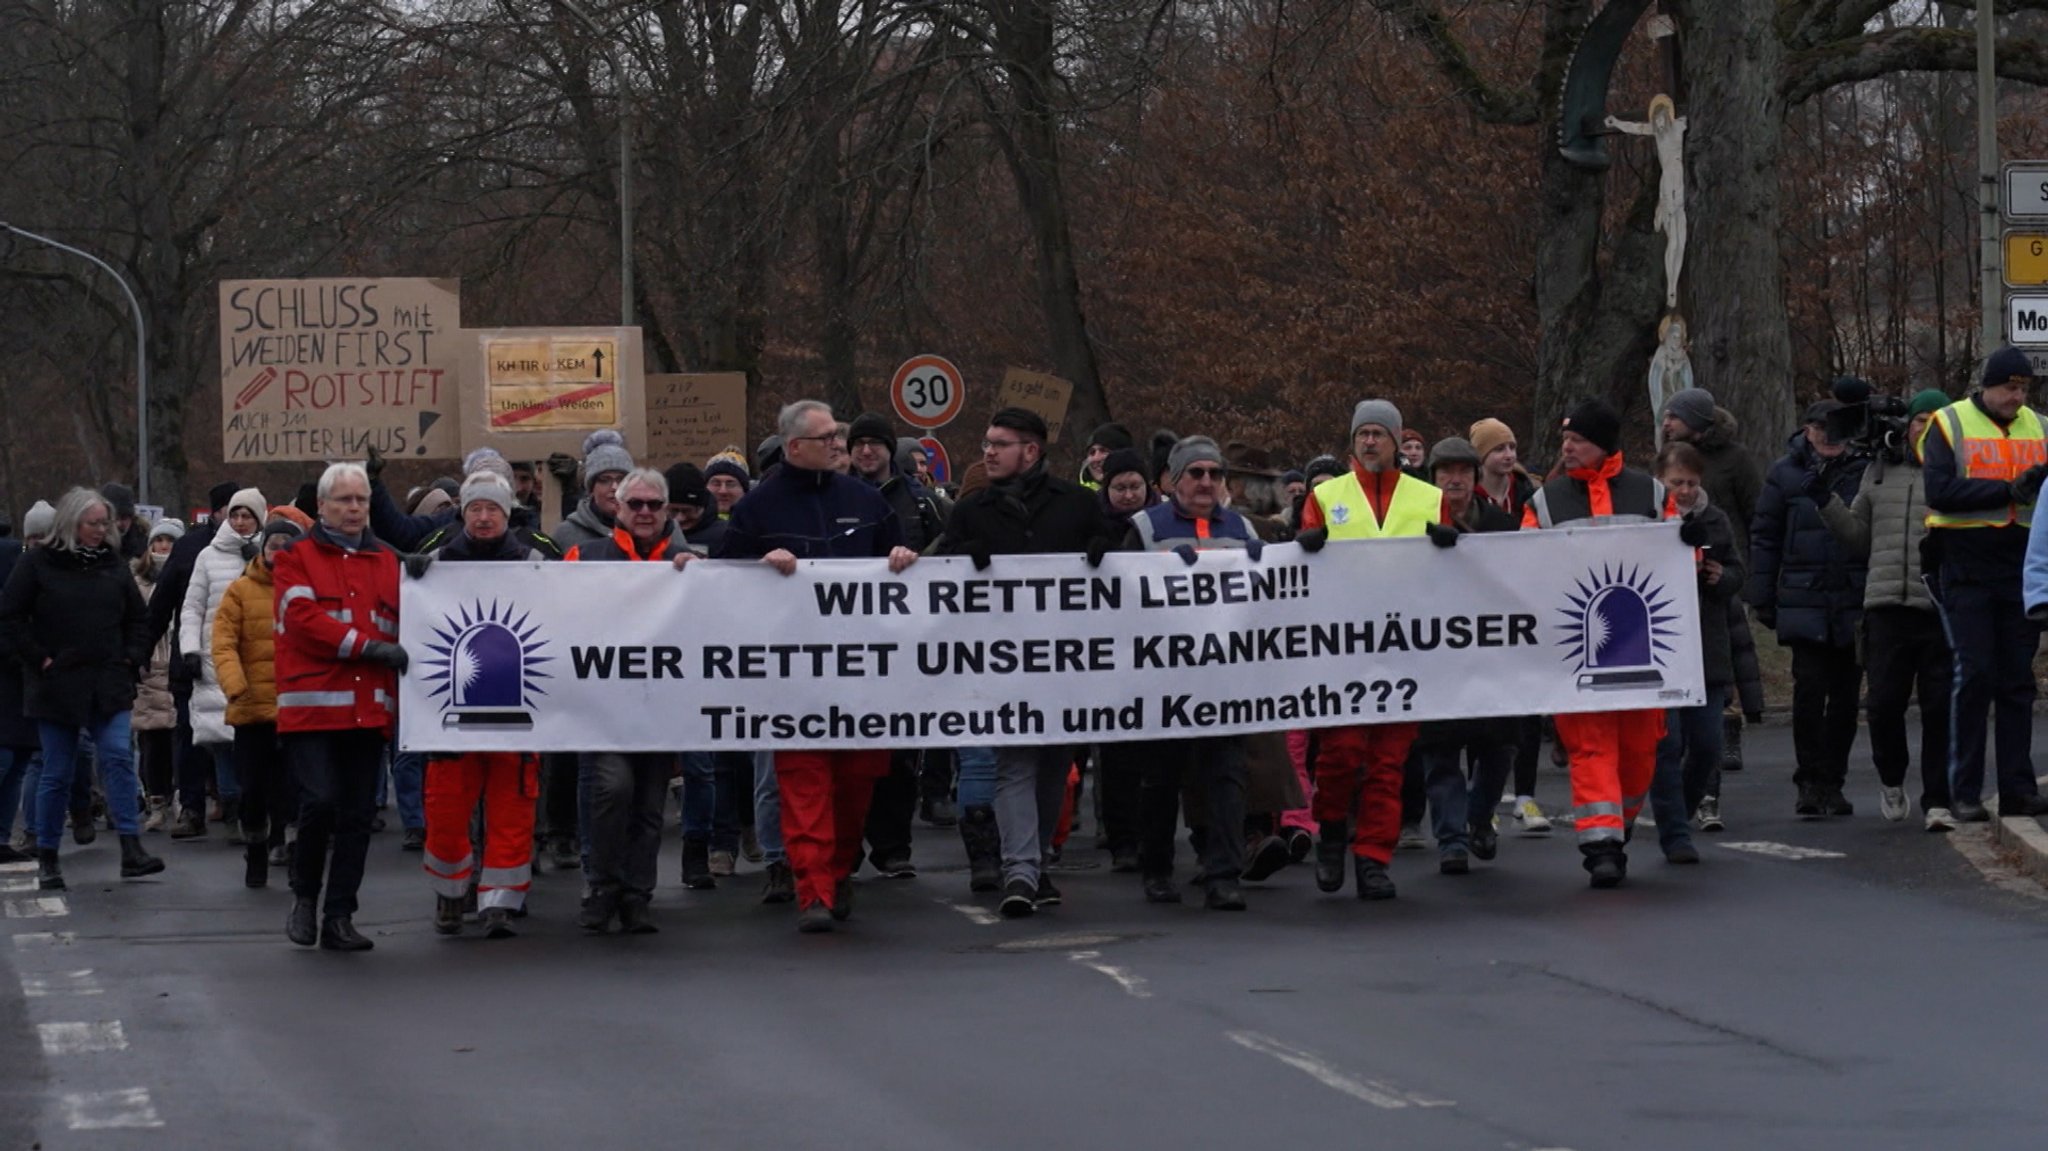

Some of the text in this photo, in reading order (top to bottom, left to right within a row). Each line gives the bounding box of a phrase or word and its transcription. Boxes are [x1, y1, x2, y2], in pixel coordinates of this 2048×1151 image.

[230, 285, 432, 332] SCHLUSS mit
[231, 330, 434, 367] WEIDEN FIRST
[497, 360, 516, 371] KH
[519, 360, 539, 371] TIR
[557, 358, 586, 370] KEM
[284, 368, 445, 410] ROTSTIFT
[559, 398, 604, 411] Weiden
[907, 375, 949, 409] 30
[227, 412, 269, 433] AUCH
[813, 565, 1310, 616] WIR RETTEN LEBEN!!!
[570, 612, 1539, 680] WER RETTET UNSERE KRANKENHÄUSER
[700, 678, 1419, 740] Tirschenreuth und Kemnath???
